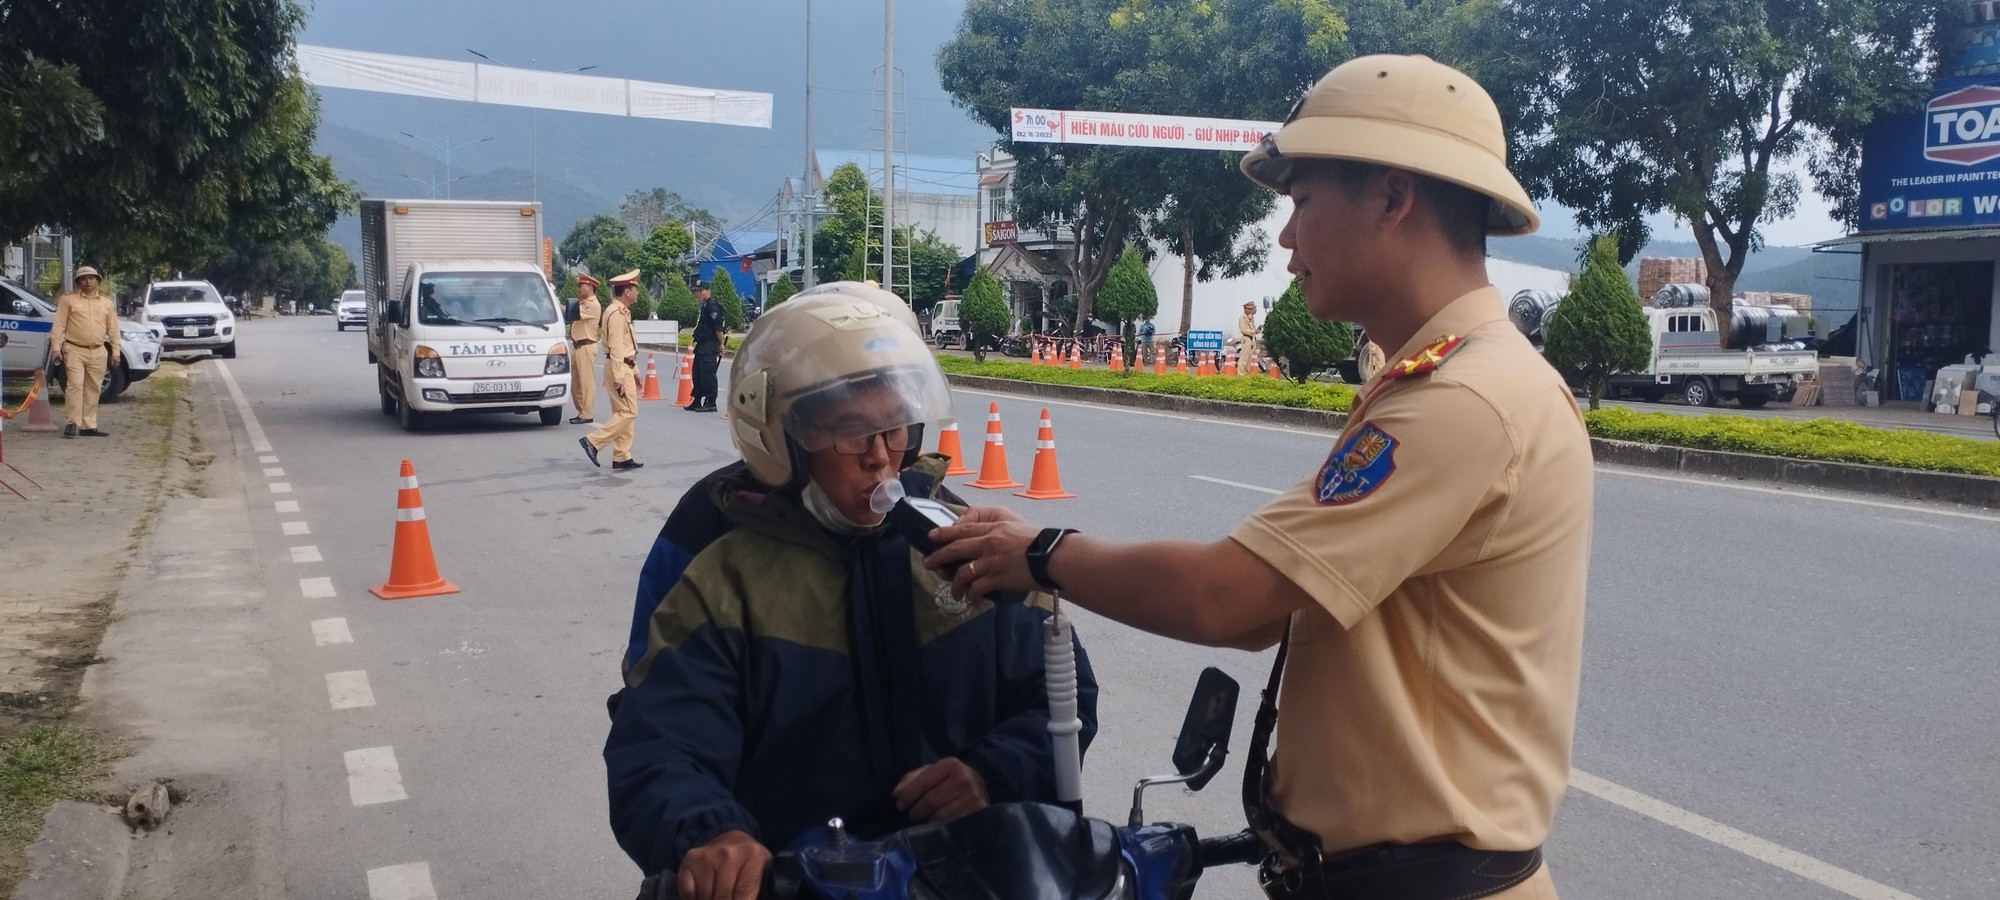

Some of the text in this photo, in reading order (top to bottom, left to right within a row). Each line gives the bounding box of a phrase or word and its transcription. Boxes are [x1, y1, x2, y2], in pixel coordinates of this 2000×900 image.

[1100, 121, 1125, 137] MÁU
[1128, 122, 1149, 139] CỨU
[1152, 123, 1184, 141] NGƯỜI
[1195, 125, 1214, 142] GIỮ
[1215, 128, 1240, 145] NHỊP
[1891, 177, 1909, 187] THE
[1910, 174, 1945, 186] LEADER
[1945, 173, 1956, 183] IN
[1957, 171, 1986, 182] PAINT
[1871, 195, 2000, 219] COLOR W
[993, 229, 1015, 240] SAIGON
[450, 341, 536, 355] TÂM PHÚC
